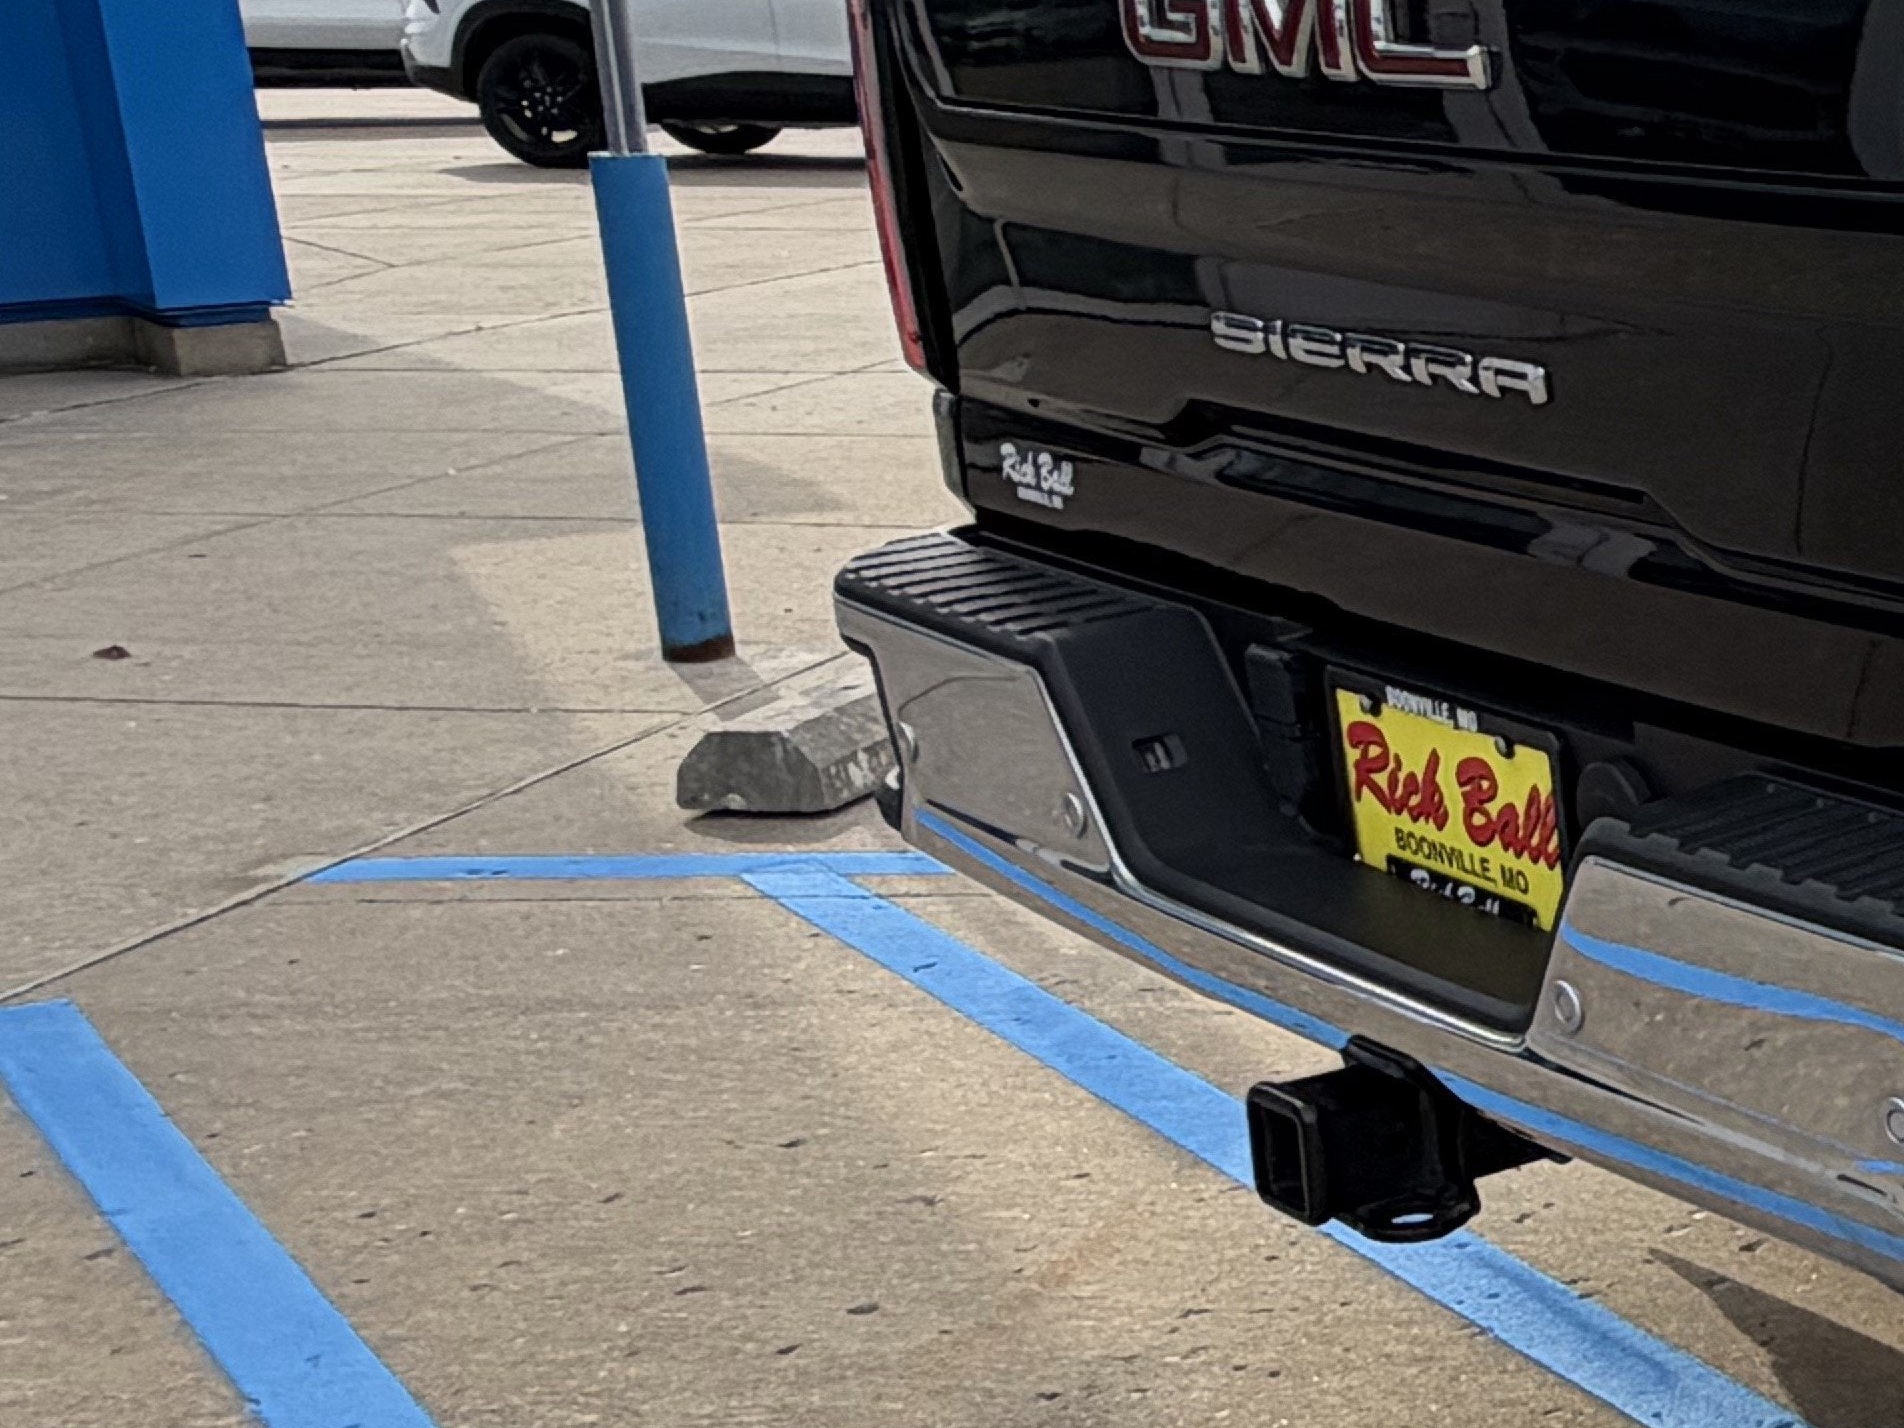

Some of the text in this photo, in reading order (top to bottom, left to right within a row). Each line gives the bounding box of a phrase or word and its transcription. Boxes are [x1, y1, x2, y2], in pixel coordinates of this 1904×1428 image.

[1210, 311, 1549, 406] SIERRA
[1000, 442, 1075, 496] Rick Ball
[1346, 720, 1561, 871] Rick Ball
[1394, 826, 1498, 888] BOONVILLE,
[1500, 863, 1530, 896] MO
